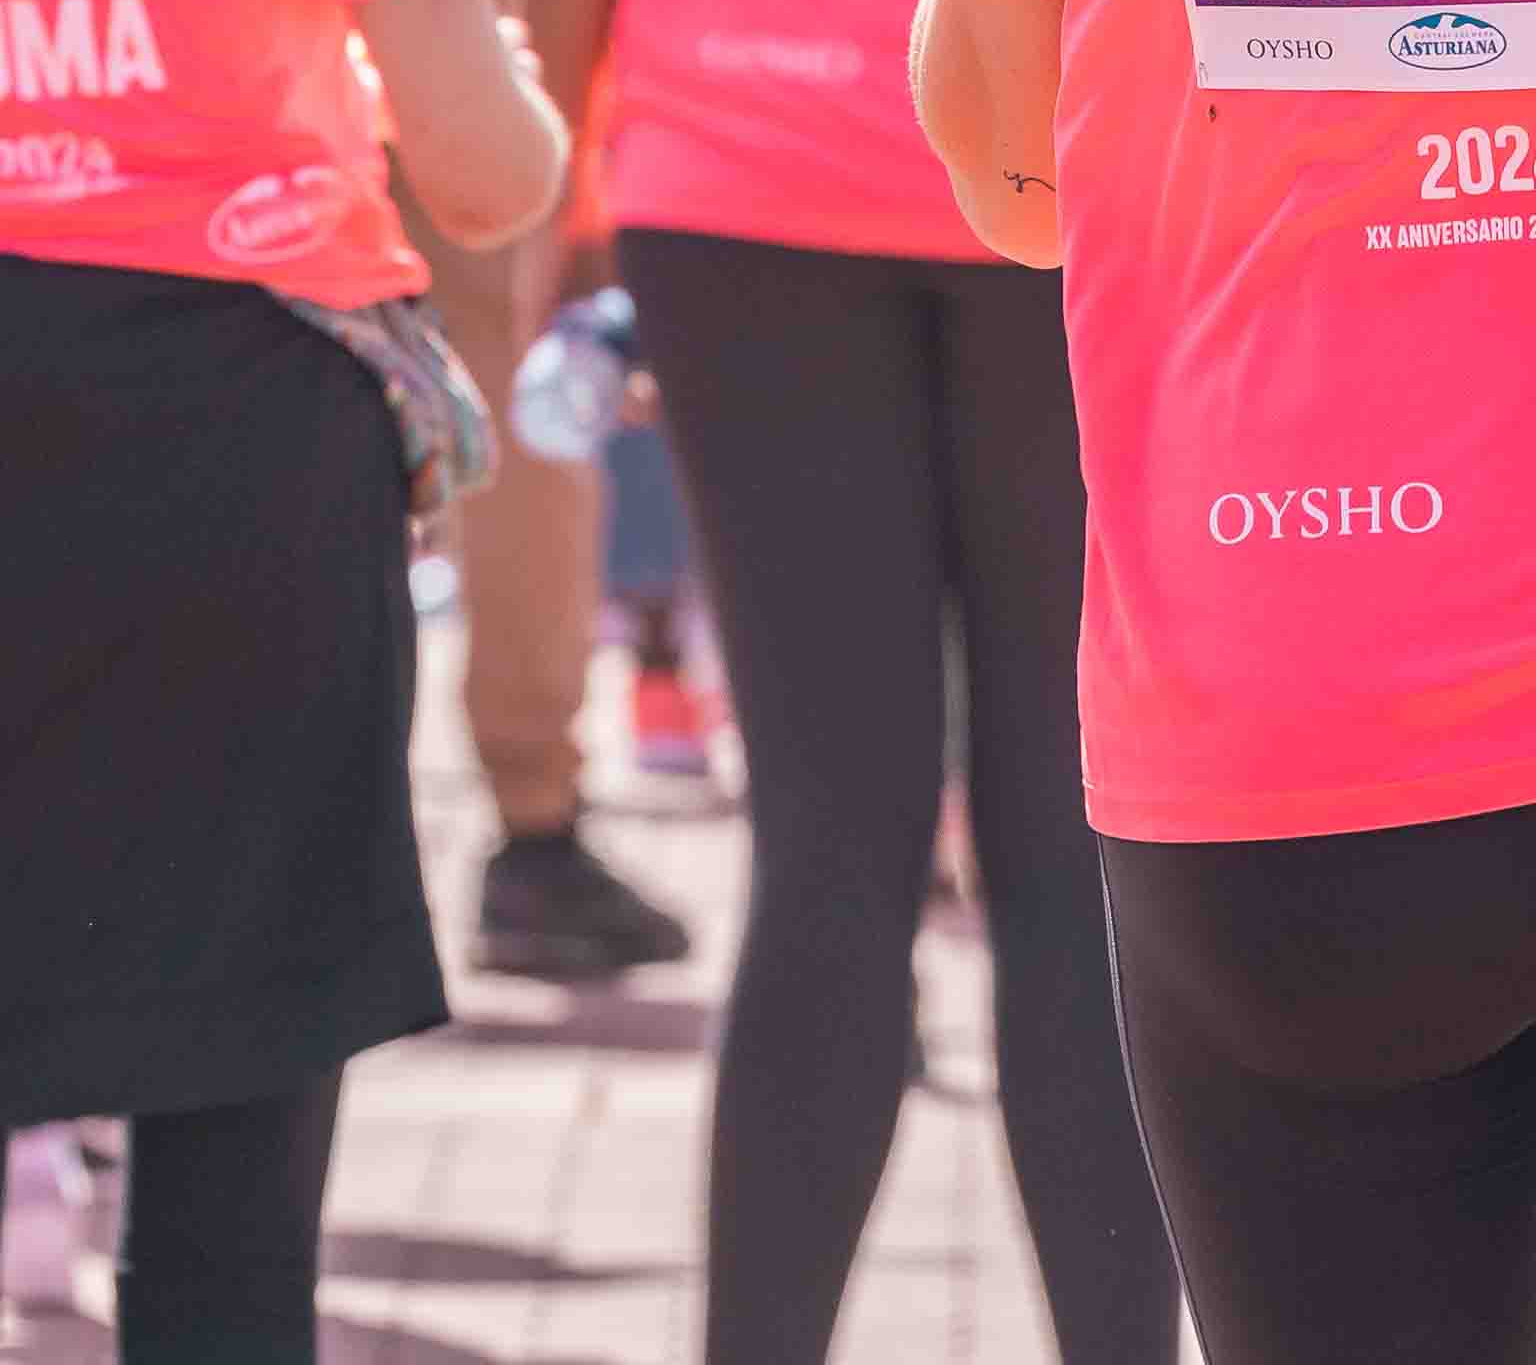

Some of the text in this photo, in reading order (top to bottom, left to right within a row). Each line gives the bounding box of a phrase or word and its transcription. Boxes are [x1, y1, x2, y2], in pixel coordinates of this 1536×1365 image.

[1247, 38, 1333, 62] OYSHO
[1398, 35, 1498, 56] ASTURIANA
[1365, 226, 1392, 250] XX
[1397, 217, 1523, 249] ANIVERSARIO
[1209, 482, 1443, 545] OYSHO
